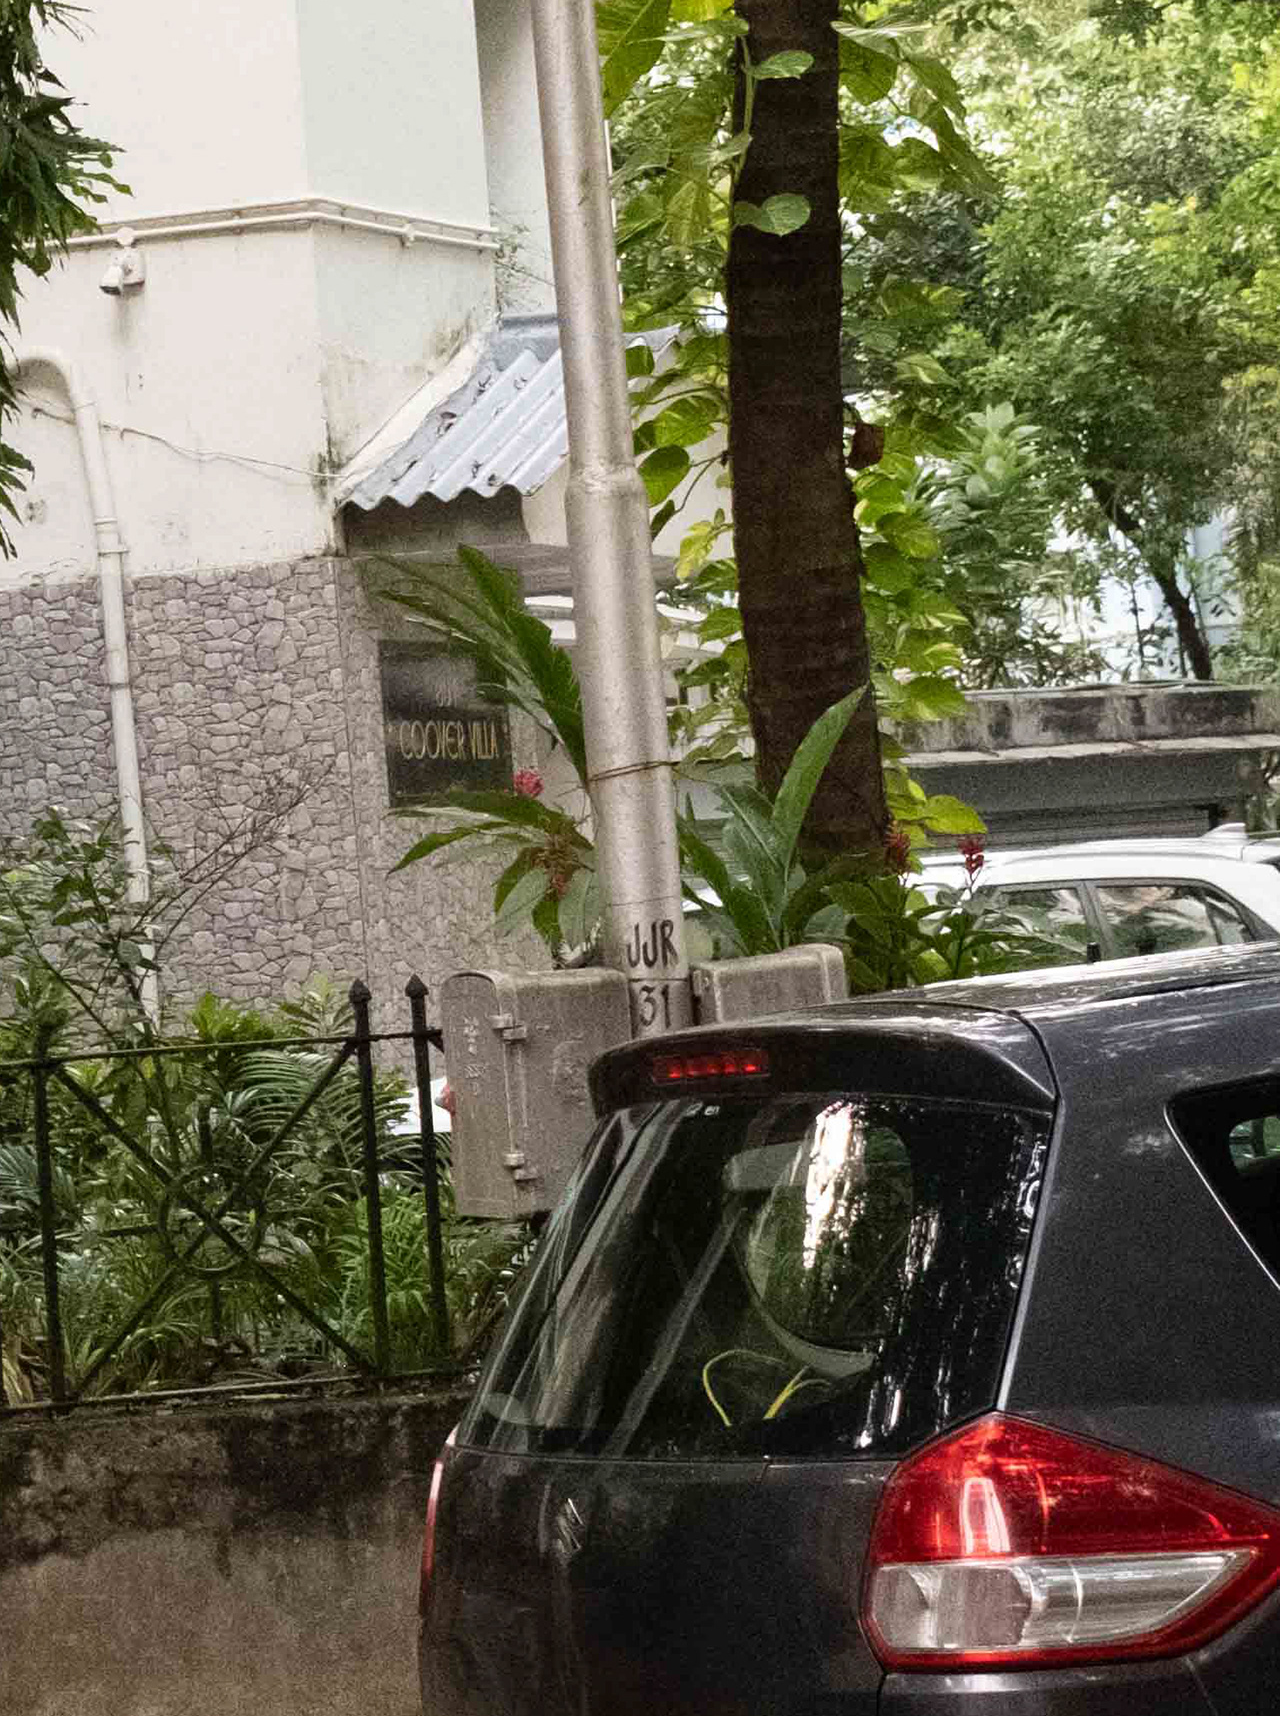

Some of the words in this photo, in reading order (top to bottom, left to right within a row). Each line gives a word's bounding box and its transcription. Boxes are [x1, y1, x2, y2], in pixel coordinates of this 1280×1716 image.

[468, 719, 500, 760] VILLA
[627, 919, 679, 968] JJR
[640, 984, 672, 1029] 31
